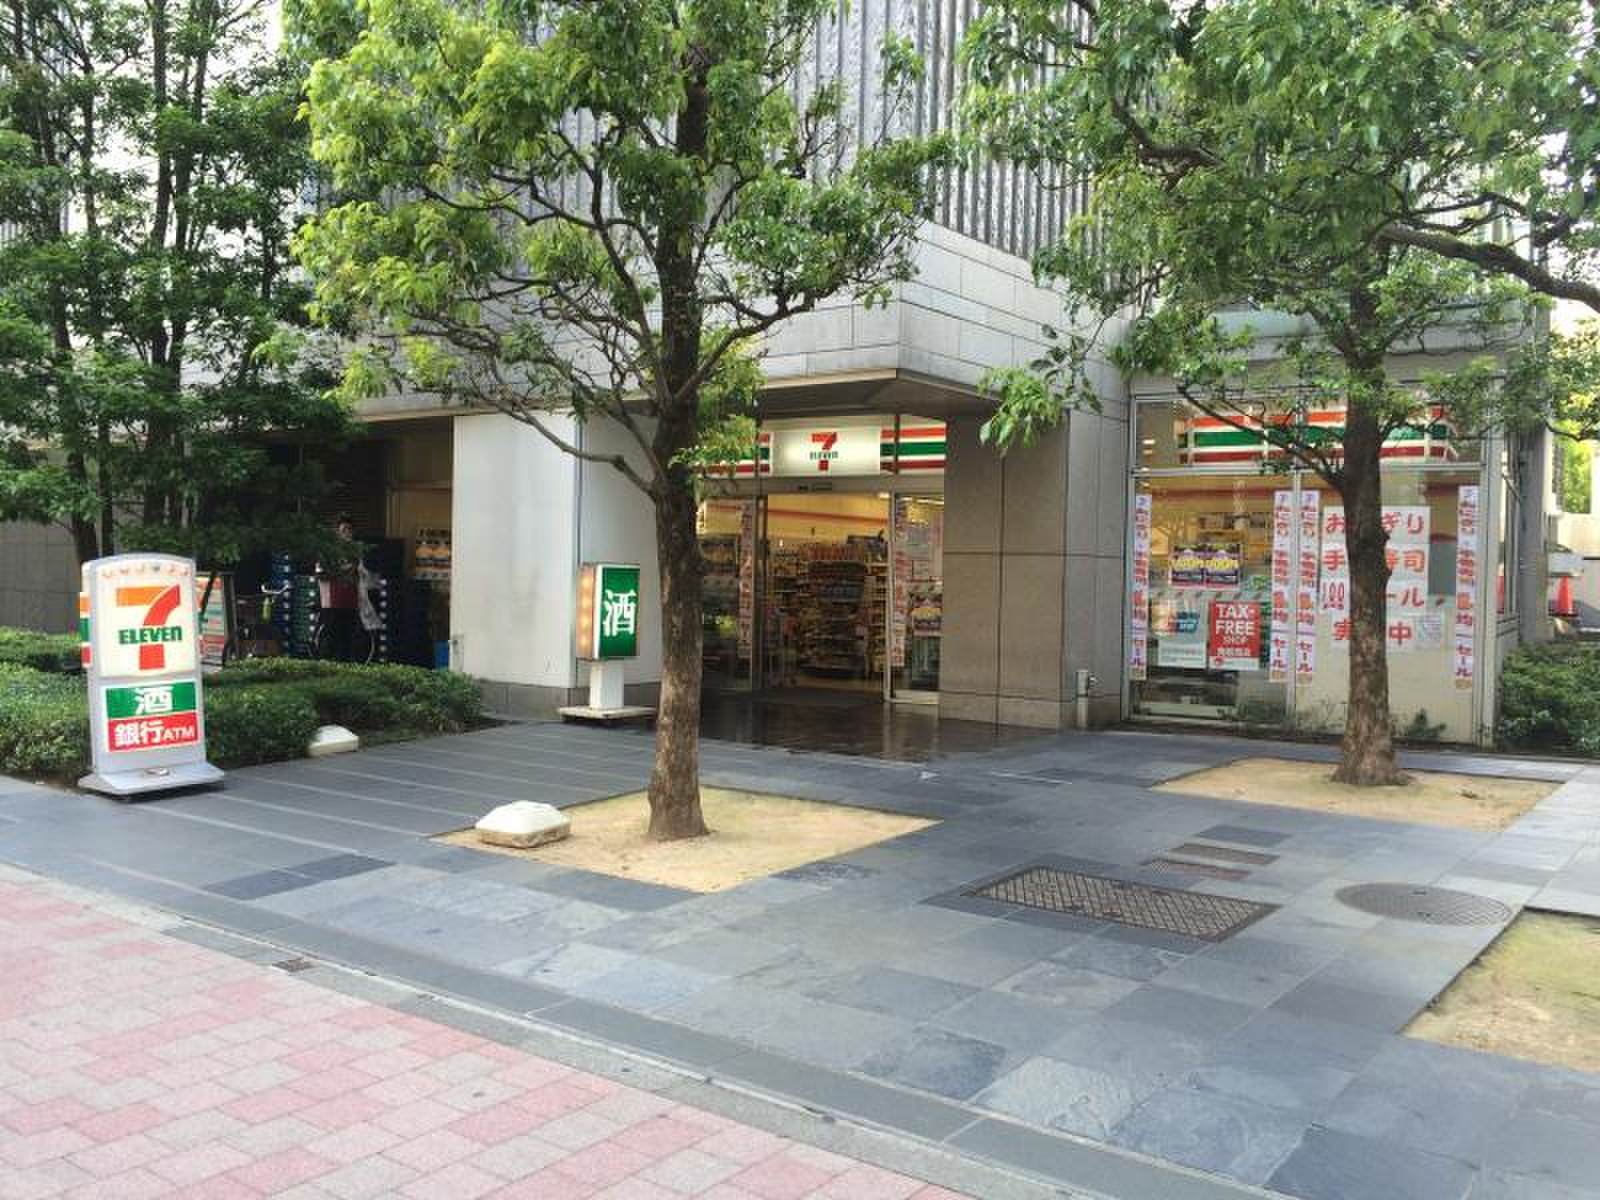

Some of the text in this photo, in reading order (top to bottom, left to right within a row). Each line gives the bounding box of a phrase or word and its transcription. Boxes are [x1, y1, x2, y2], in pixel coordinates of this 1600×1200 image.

[1327, 511, 1424, 535] おぎり
[116, 583, 181, 671] 7
[603, 589, 637, 637] 酒
[1215, 621, 1255, 636] FREE
[1332, 619, 1412, 646] 実中
[134, 686, 173, 715] 酒
